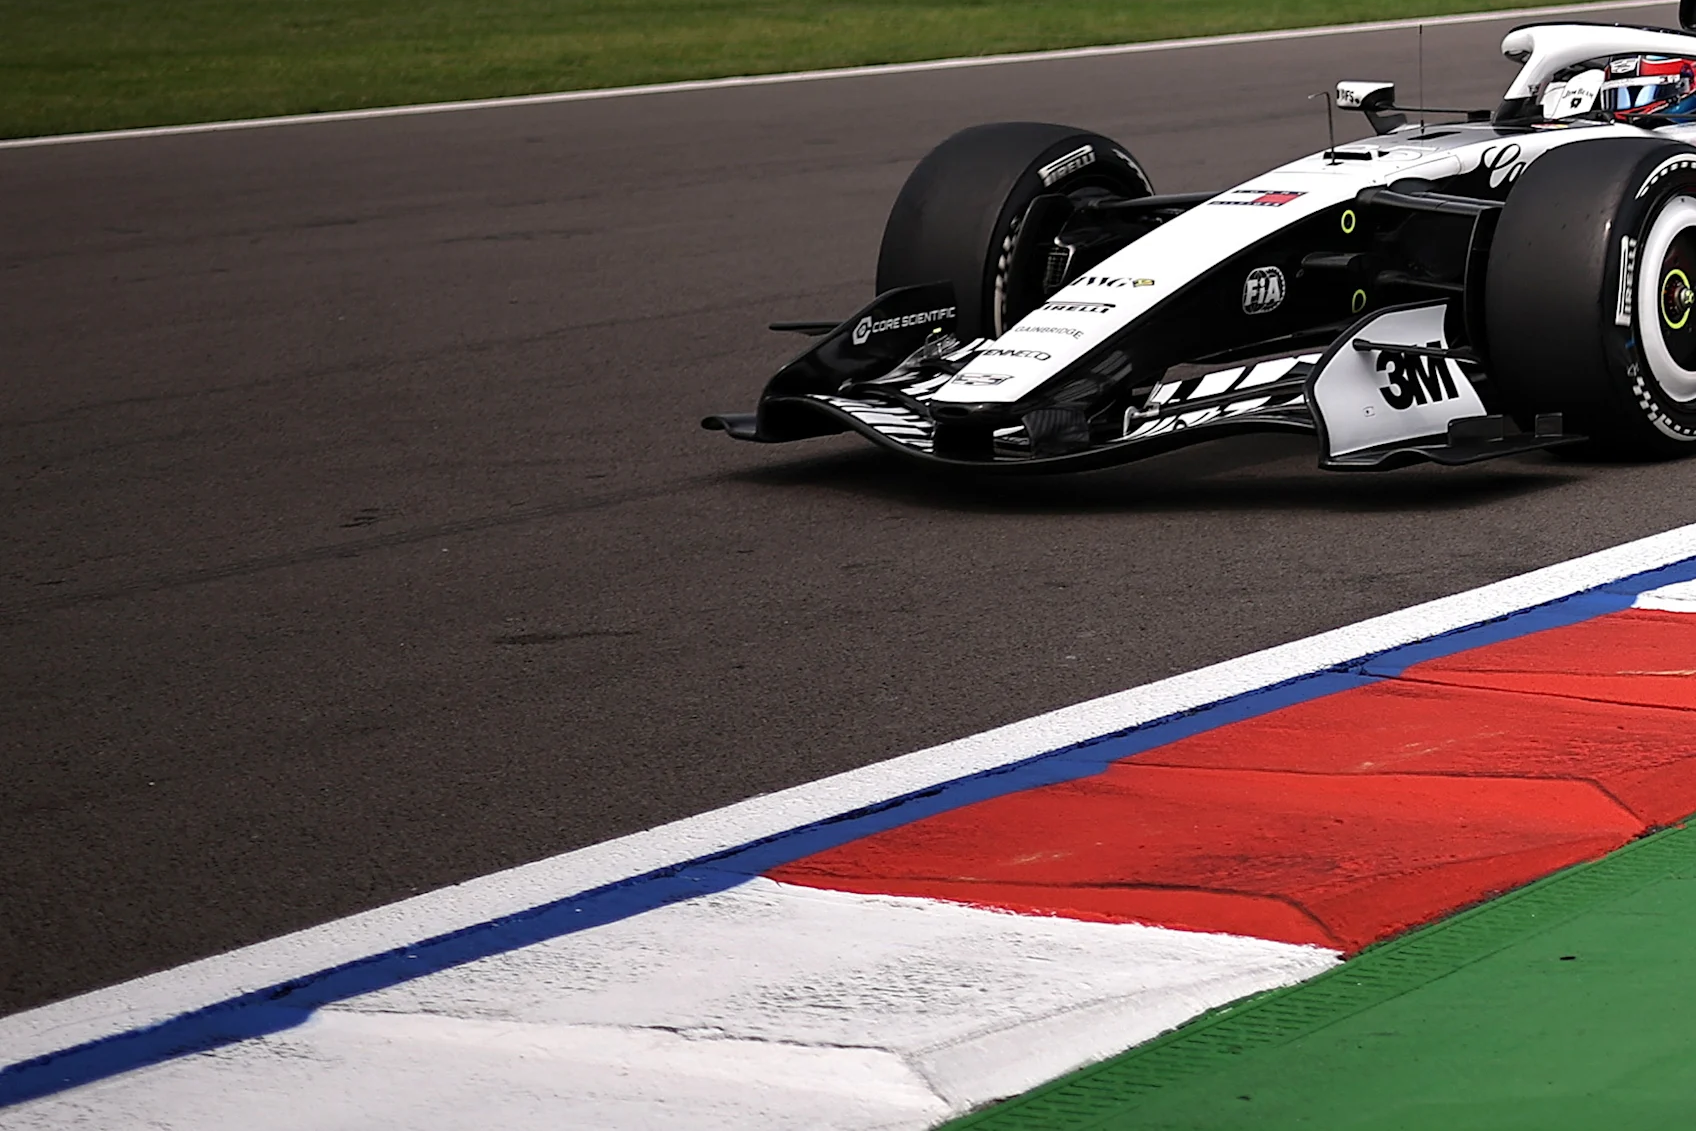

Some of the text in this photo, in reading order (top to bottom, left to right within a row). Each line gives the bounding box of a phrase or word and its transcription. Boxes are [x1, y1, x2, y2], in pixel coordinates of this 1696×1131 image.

[1037, 143, 1096, 188] PIRELLI
[1615, 234, 1637, 326] PIRELLI
[872, 306, 956, 333] CORE SCIENTIFIC
[1014, 326, 1085, 340] GAINBRIDGE
[1376, 340, 1460, 411] 3M
